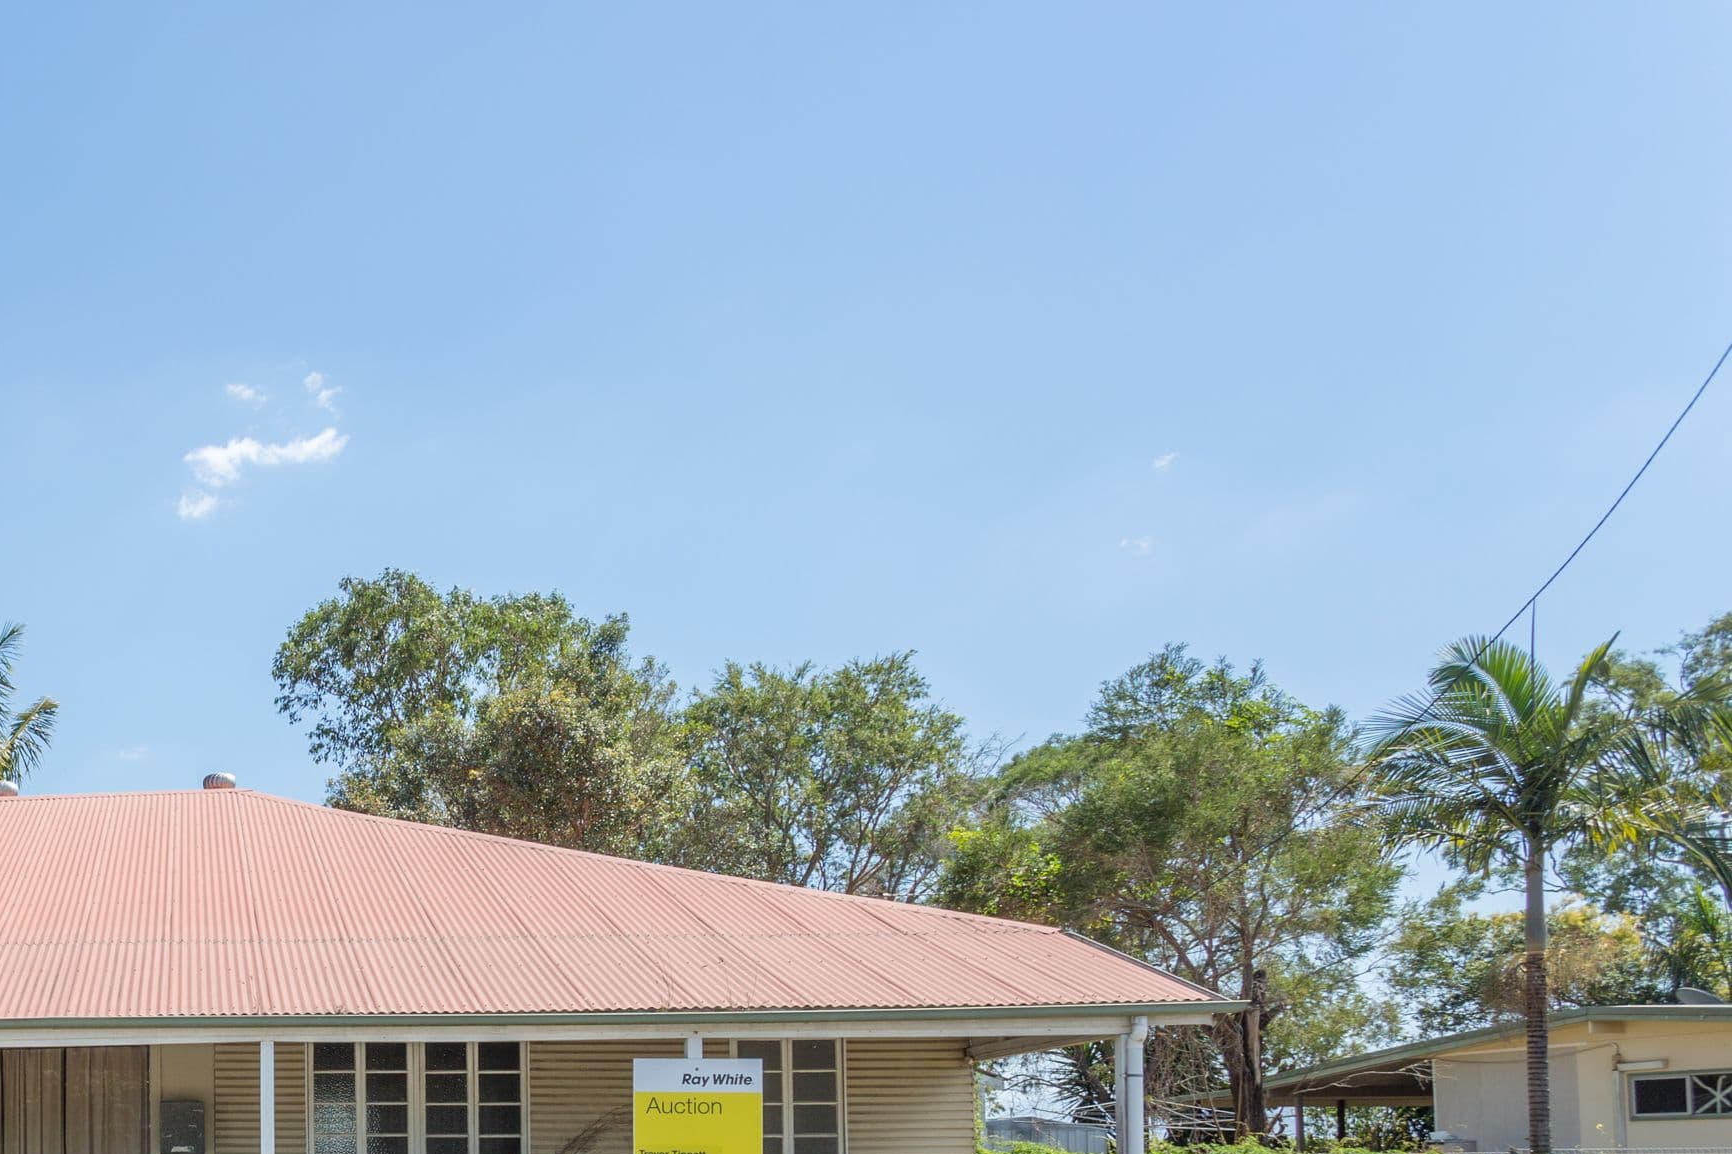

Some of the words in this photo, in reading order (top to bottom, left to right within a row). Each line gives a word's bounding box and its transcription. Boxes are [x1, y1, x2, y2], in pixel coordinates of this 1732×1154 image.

[681, 1073, 710, 1087] Ray
[712, 1073, 753, 1086] White
[646, 1097, 722, 1115] Auction
